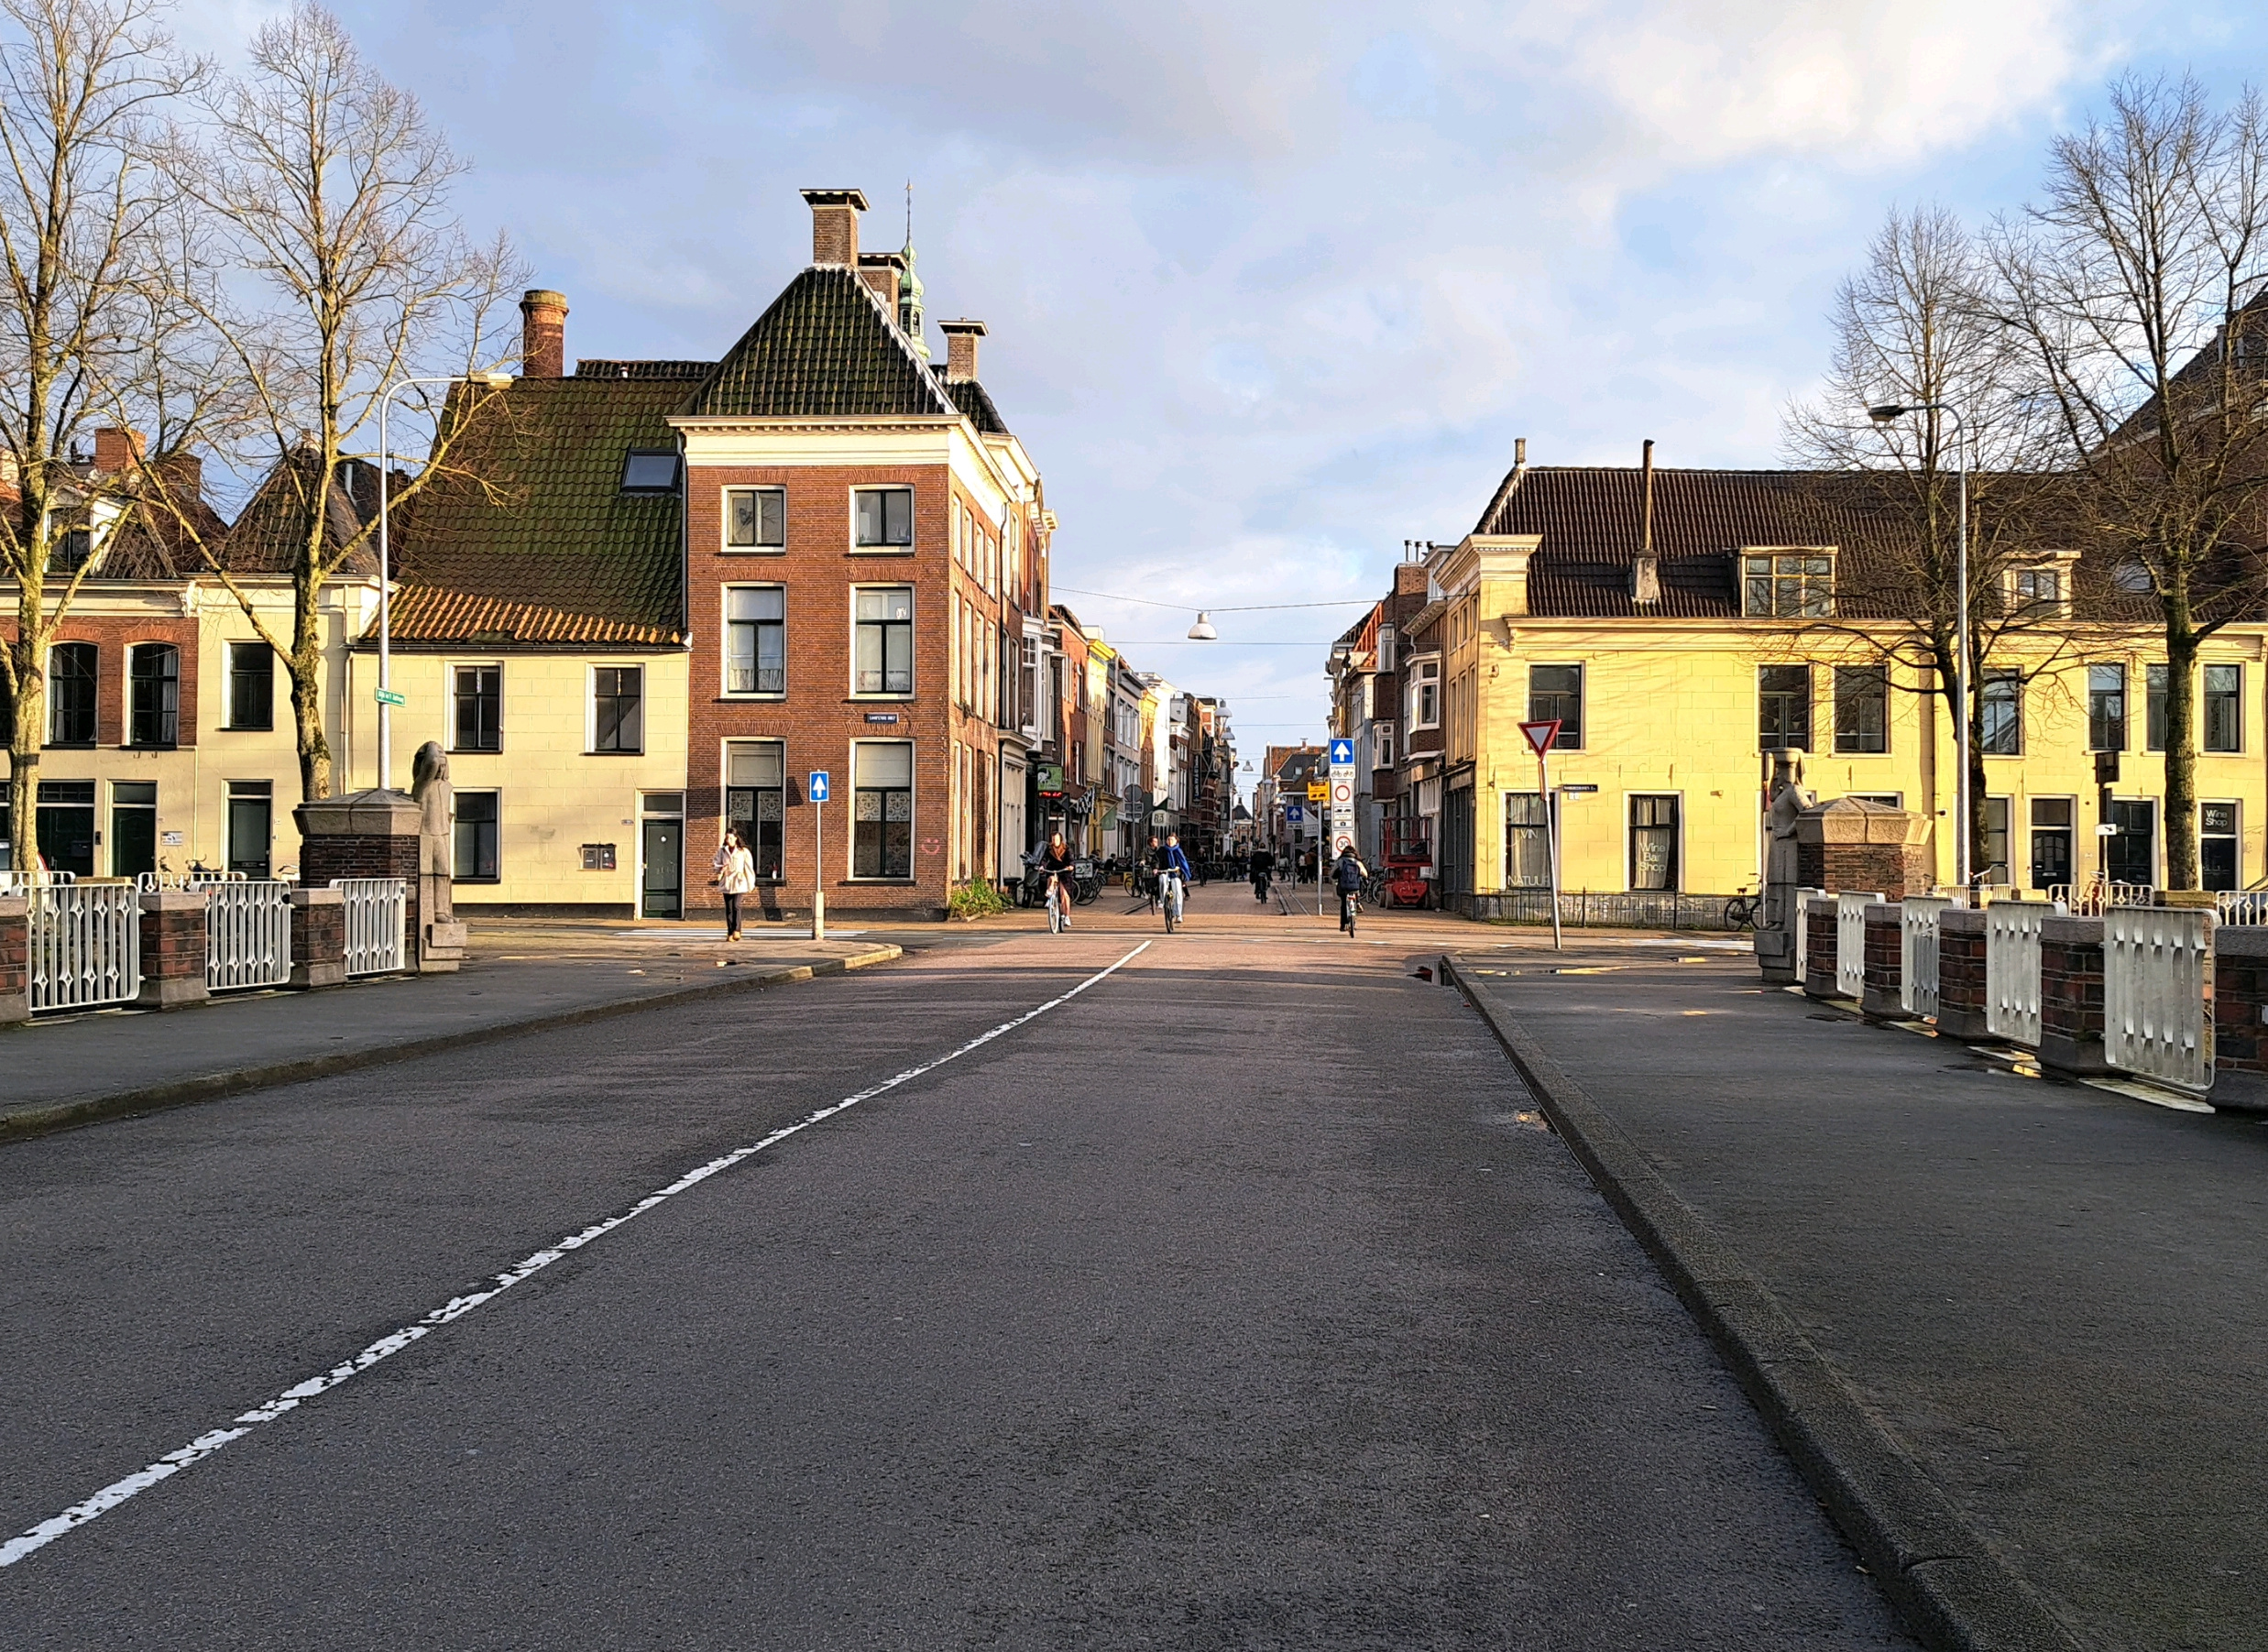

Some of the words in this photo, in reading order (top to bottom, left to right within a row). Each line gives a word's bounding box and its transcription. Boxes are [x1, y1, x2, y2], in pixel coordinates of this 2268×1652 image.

[2205, 809, 2228, 818] Wine
[2205, 818, 2228, 827] Shop
[1520, 829, 1538, 839] VIN
[1639, 842, 1666, 852] Wine
[1643, 852, 1660, 861] Bar
[1639, 861, 1666, 873] Shop
